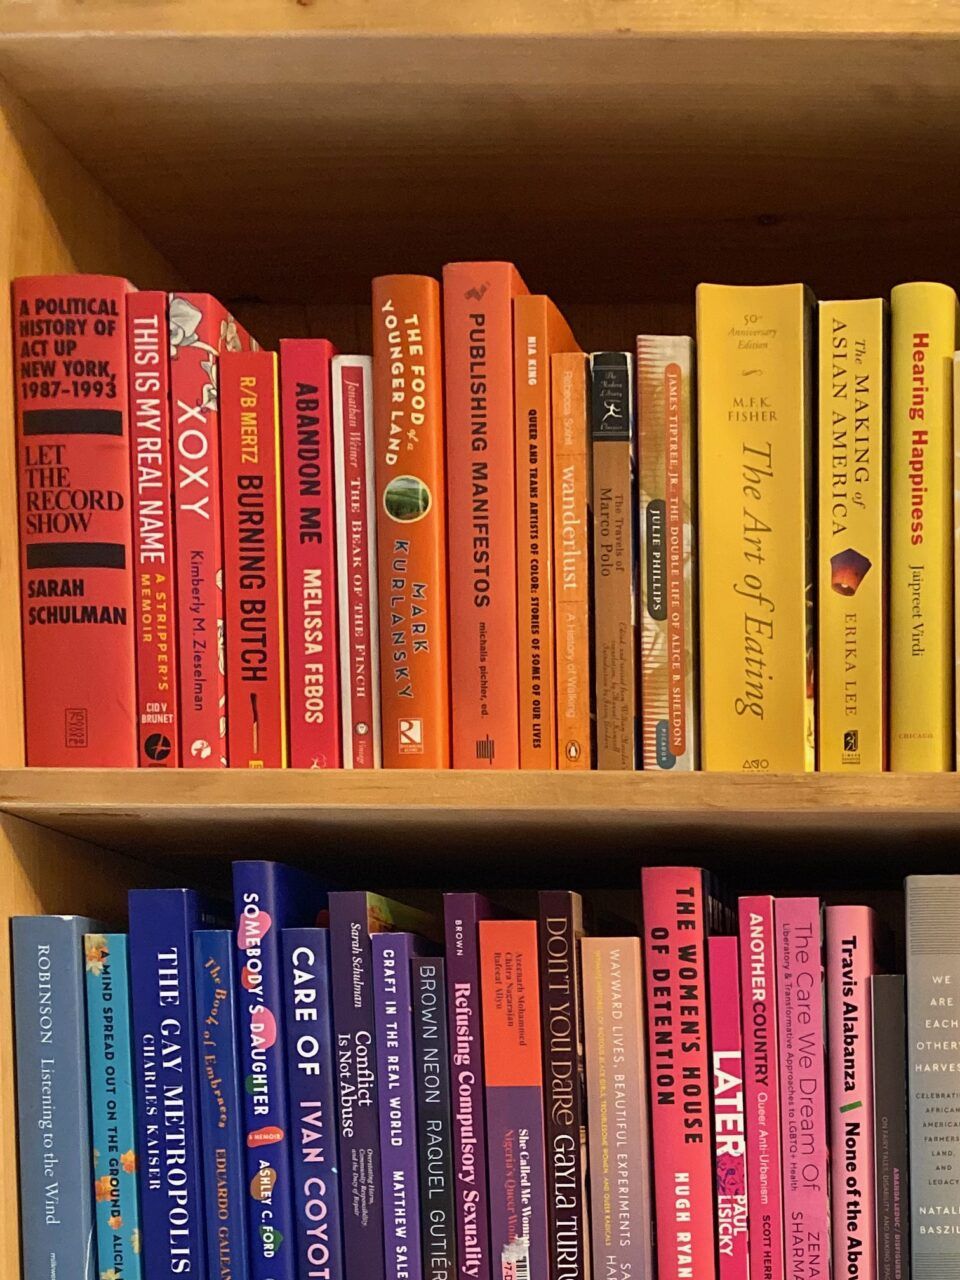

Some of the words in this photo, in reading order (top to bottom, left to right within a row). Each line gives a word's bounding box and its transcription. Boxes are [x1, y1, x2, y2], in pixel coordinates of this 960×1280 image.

[20, 300, 30, 315] A
[35, 299, 118, 315] POLITICAL
[20, 320, 86, 338] HISTORY
[95, 320, 116, 336] OF
[20, 342, 43, 356] ACT
[50, 342, 77, 355] UP
[134, 315, 158, 366] THIS
[21, 362, 56, 378] NEW
[61, 361, 116, 379] YORK,
[135, 371, 159, 391] IS
[909, 332, 929, 420] Hearing
[137, 397, 161, 436] MY
[25, 445, 65, 464] LET
[138, 438, 163, 494] REAL
[177, 401, 209, 520] XOXY
[743, 442, 773, 501] The
[25, 468, 70, 487] THE
[910, 429, 928, 545] Happiness
[25, 491, 124, 511] RECORD
[27, 514, 91, 534] SHOW
[140, 499, 165, 564] NAME
[650, 509, 660, 550] JULIE
[745, 520, 771, 566] Art
[28, 580, 84, 597] SARAH
[652, 552, 662, 612] PHILLIPS
[734, 574, 775, 612] of
[29, 607, 126, 625] SCHULMAN
[735, 612, 775, 720] Eating
[244, 893, 265, 1014] SOMEBODY'S
[842, 936, 857, 995] Travis
[156, 948, 178, 1008] THE
[292, 948, 317, 1021] CARE
[932, 976, 951, 984] WE
[930, 998, 954, 1006] ARE
[162, 1017, 181, 1075] GAY
[842, 998, 857, 1091] Alabanza
[925, 1020, 959, 1029] EACH
[250, 1022, 269, 1115] DAUGHTER
[297, 1038, 320, 1075] OF
[300, 1102, 324, 1163] IVAN
[162, 1086, 191, 1275] METROPOLIS
[763, 1216, 772, 1254] SCOTT
